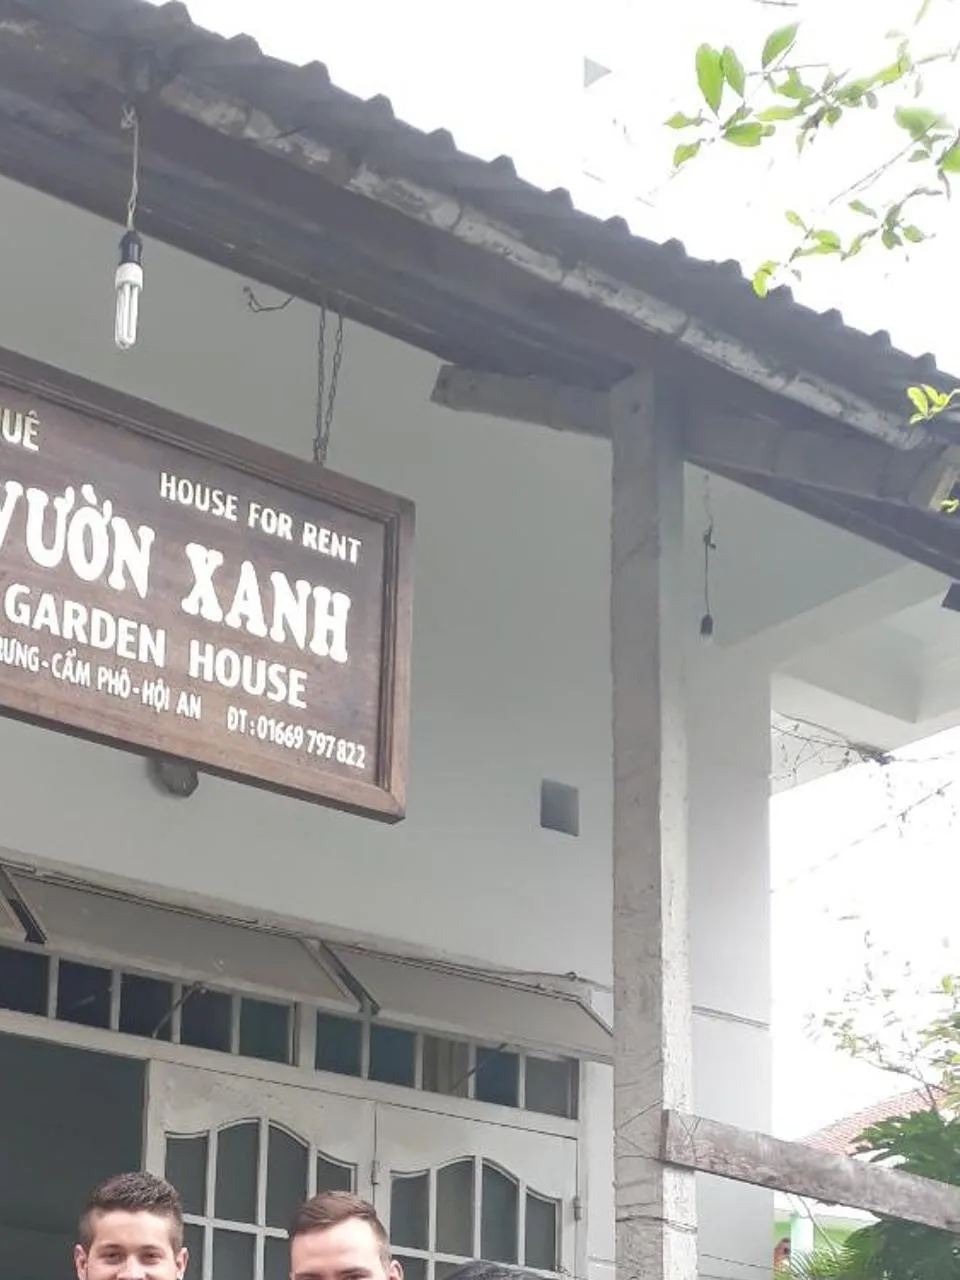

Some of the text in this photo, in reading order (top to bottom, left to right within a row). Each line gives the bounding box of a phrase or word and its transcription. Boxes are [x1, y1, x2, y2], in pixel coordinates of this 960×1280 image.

[160, 472, 362, 564] HOUSE FOR RENT
[3, 583, 166, 668] GARDEN
[189, 639, 308, 709] HOUSE
[181, 542, 352, 663] XANH
[176, 691, 202, 720] AN
